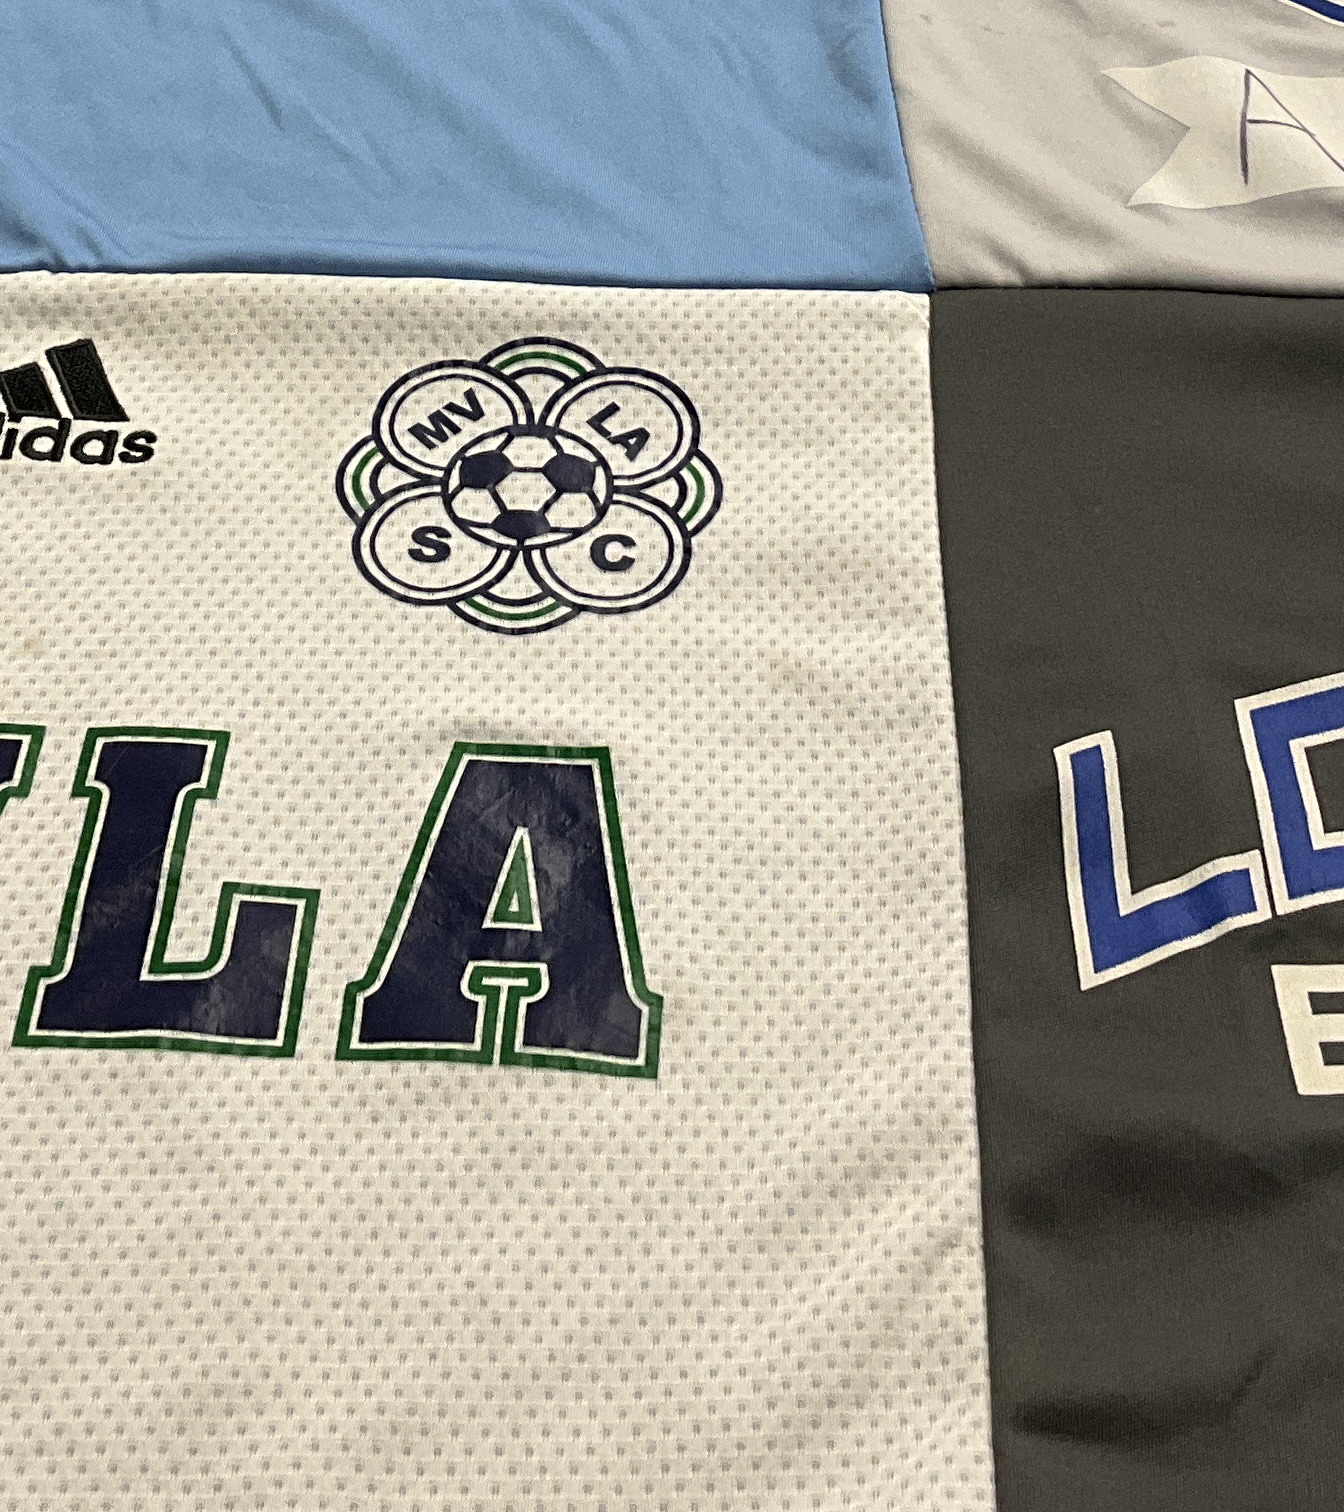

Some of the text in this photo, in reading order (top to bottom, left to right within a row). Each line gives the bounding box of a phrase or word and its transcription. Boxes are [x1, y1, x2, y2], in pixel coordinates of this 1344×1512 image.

[407, 387, 652, 465] MV LA
[406, 524, 637, 575] S C
